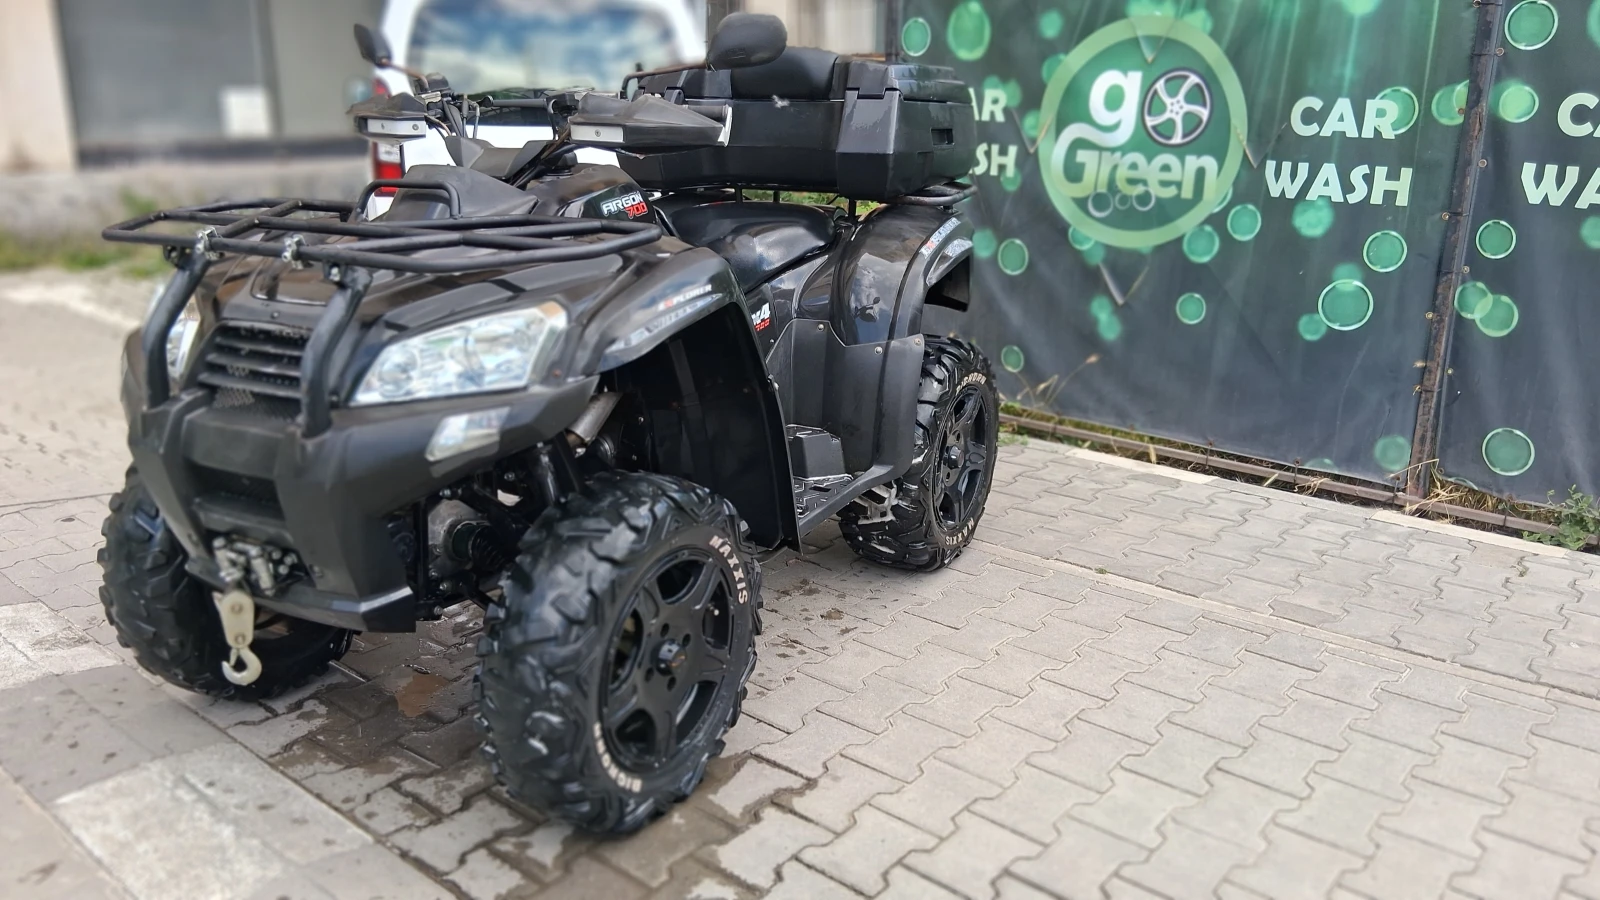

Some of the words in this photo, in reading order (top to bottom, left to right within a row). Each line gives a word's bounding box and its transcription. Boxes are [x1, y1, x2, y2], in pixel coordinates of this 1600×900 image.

[1290, 96, 1400, 139] CAR
[1557, 92, 1600, 138] C
[1051, 122, 1219, 200] Green
[602, 191, 644, 216] ARGON
[1264, 160, 1413, 207] WASH
[625, 201, 649, 218] 700
[945, 516, 975, 545] MAXXIS
[708, 535, 748, 604] MAXXIS
